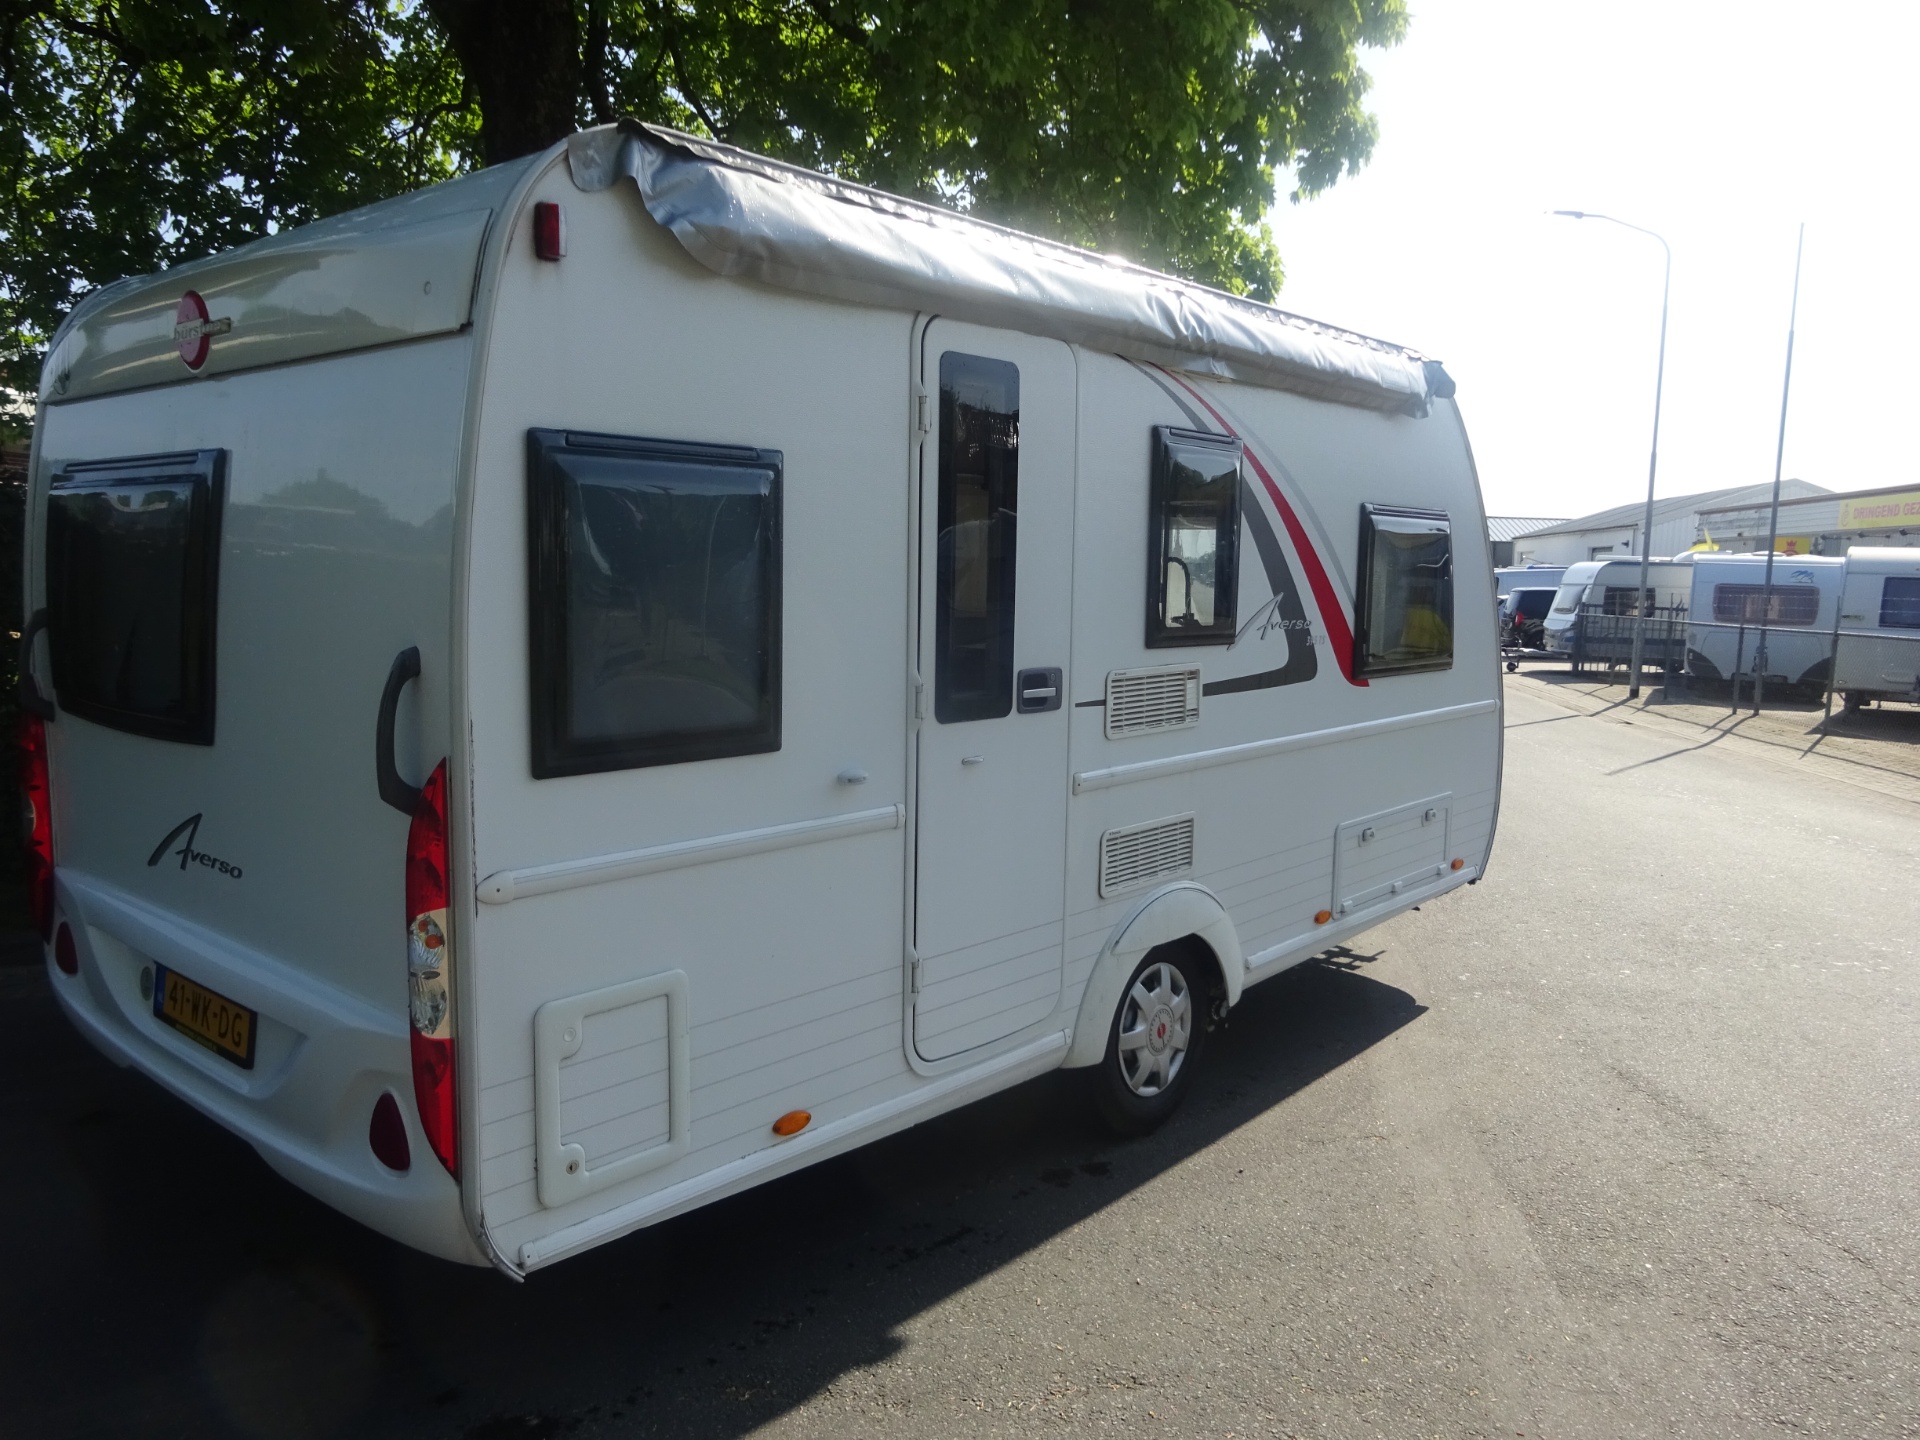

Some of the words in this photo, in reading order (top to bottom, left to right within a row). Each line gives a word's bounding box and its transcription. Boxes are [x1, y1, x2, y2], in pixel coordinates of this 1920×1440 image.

[1853, 504, 1900, 519] DRINGEND
[1226, 592, 1312, 651] Averso
[147, 812, 243, 880] Averso
[168, 980, 242, 1048] 41-WK-DG
